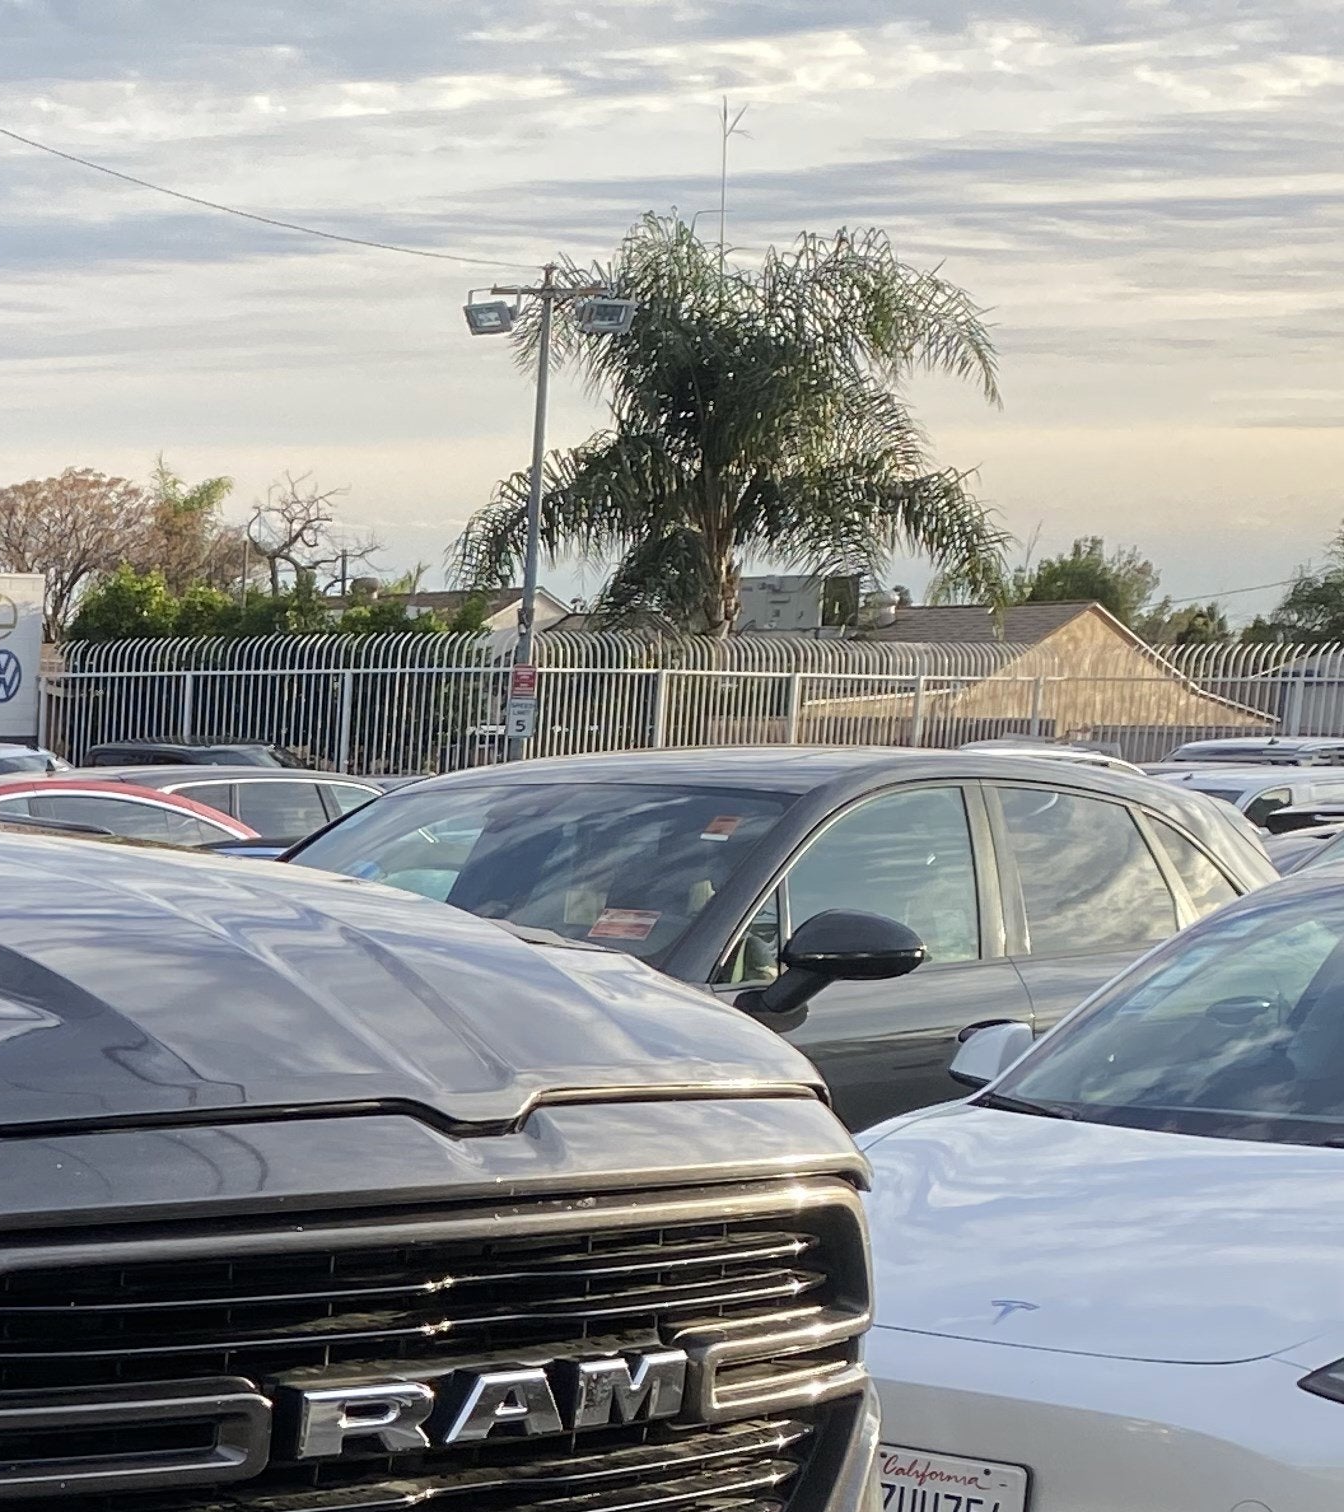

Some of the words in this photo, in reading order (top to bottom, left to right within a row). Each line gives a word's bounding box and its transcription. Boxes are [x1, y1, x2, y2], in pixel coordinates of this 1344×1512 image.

[515, 719, 526, 733] 5
[297, 1348, 688, 1460] RAM
[883, 1454, 992, 1490] California
